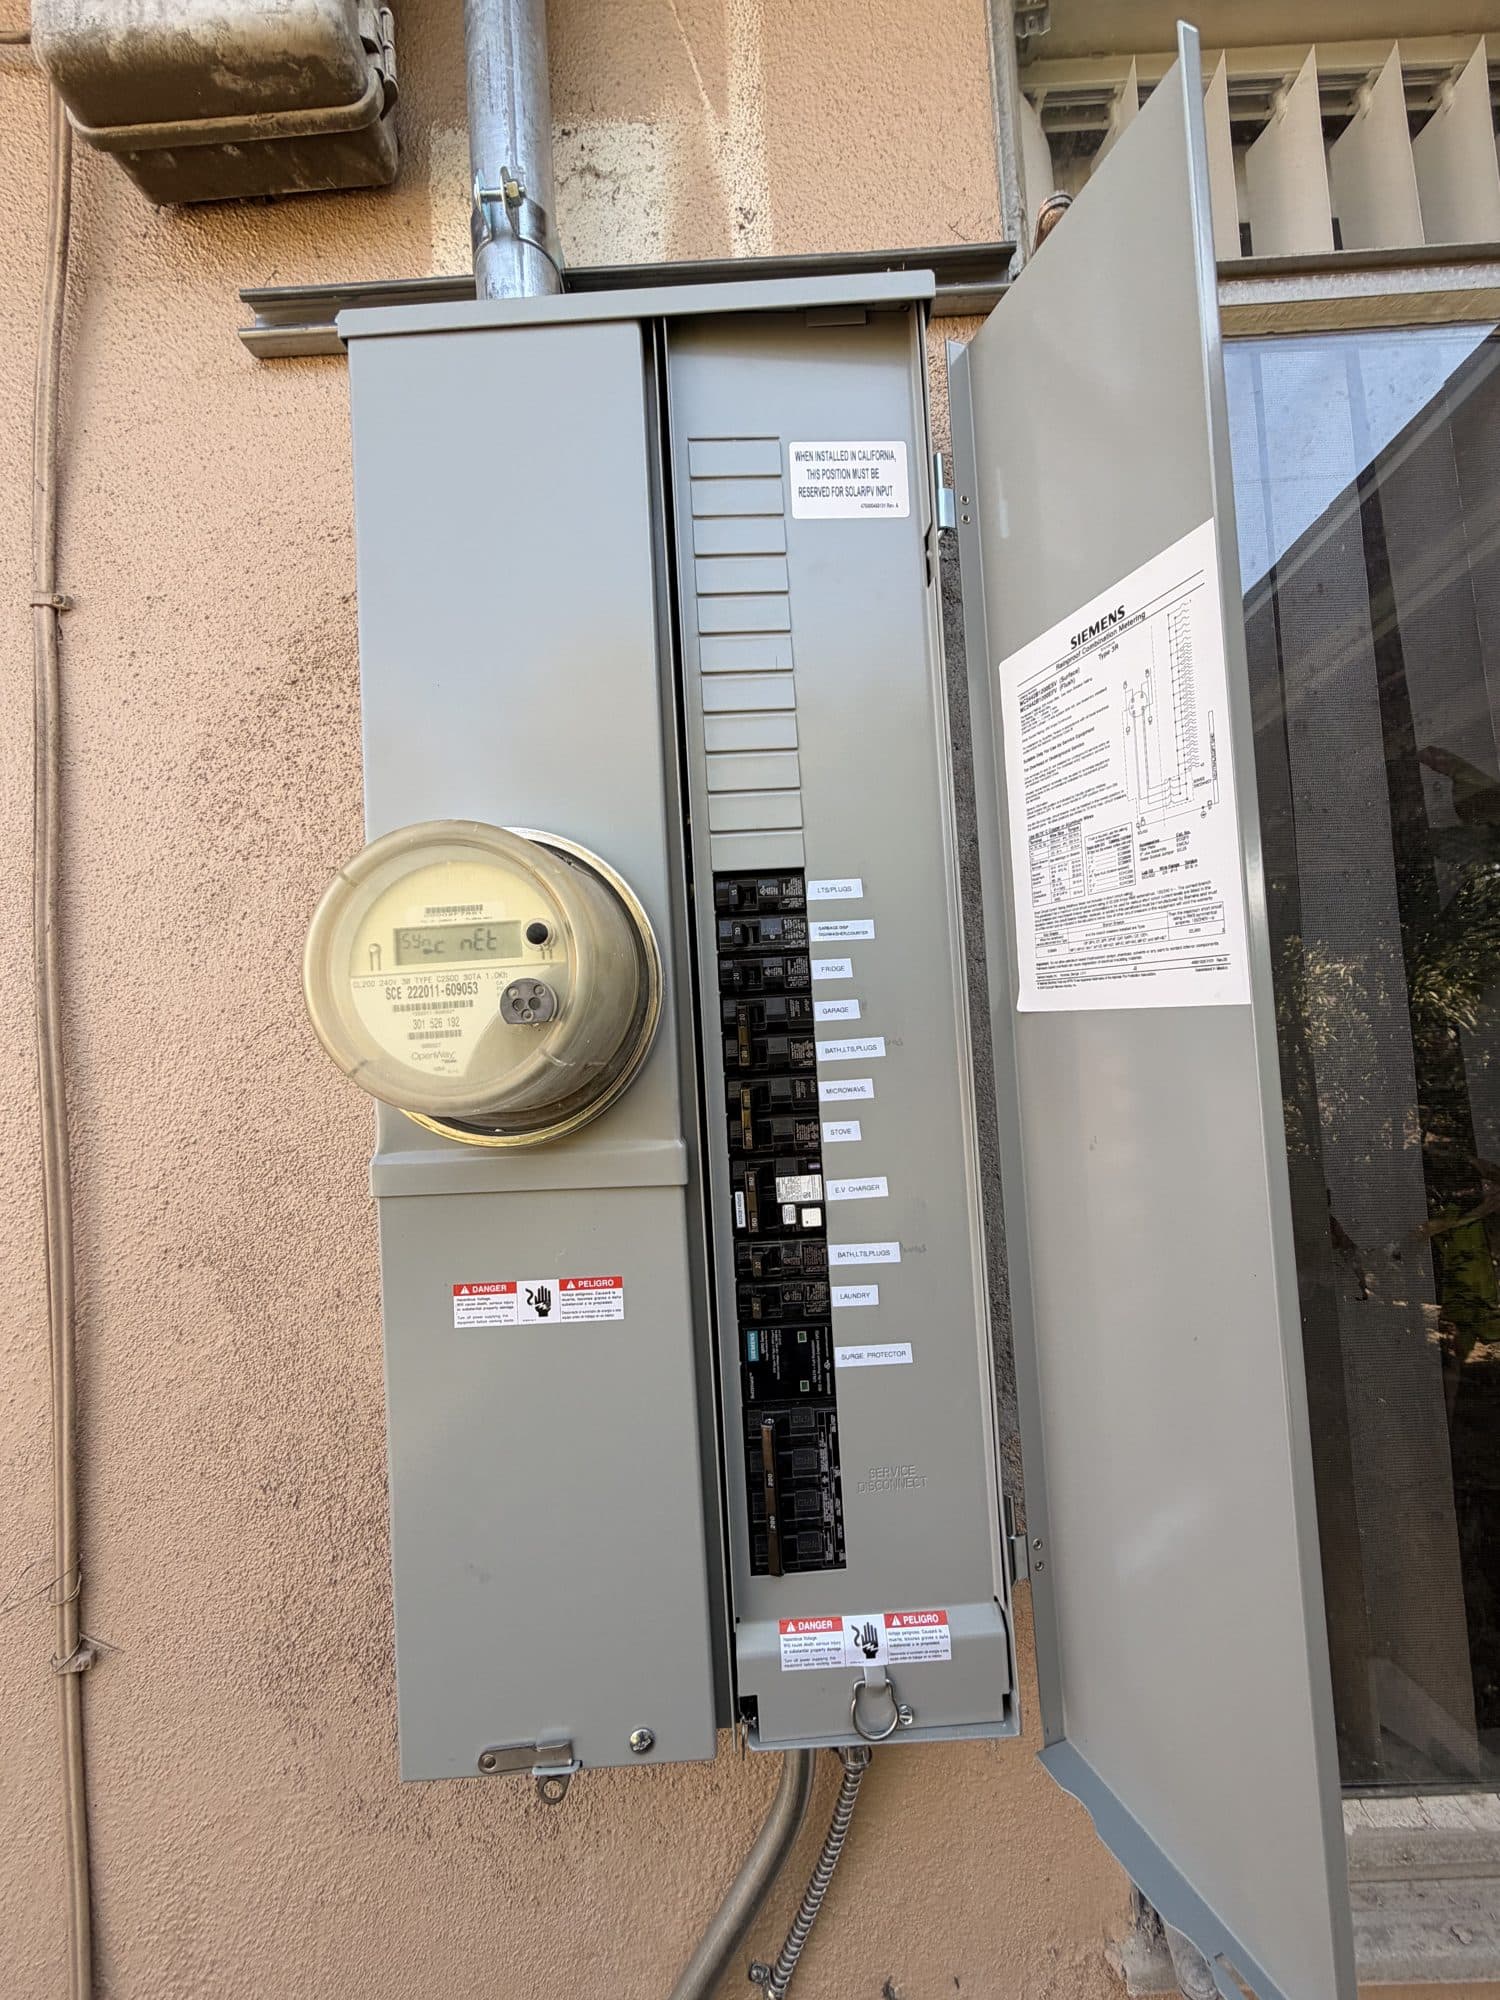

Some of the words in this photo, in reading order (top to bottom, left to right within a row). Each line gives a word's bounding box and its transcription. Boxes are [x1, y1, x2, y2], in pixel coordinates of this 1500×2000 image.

[795, 450, 814, 462] WHEN
[815, 450, 849, 461] INSTALLED
[850, 449, 857, 461] IN
[858, 449, 897, 462] CALIFORNIA,
[807, 468, 821, 480] THIS
[822, 468, 851, 479] POSITION
[852, 468, 870, 479] MUST
[871, 467, 880, 479] BE
[799, 486, 830, 498] RESERVED
[831, 486, 844, 497] FOR
[876, 485, 893, 496] INPUT
[1070, 605, 1126, 650] SIEMENS
[1082, 629, 1118, 654] Combination
[1118, 611, 1146, 632] Metering
[385, 987, 401, 1000] SCE
[407, 982, 478, 999] 222011-609053
[823, 1006, 848, 1014] GARAGE
[826, 1086, 867, 1095] MICROWAVE
[848, 1184, 880, 1192] CHARGER
[472, 1285, 507, 1293] DANGER
[578, 1280, 614, 1288] PELIGRO
[840, 1292, 871, 1300] LAUNDRY
[841, 1352, 863, 1360] SURGE
[867, 1350, 906, 1359] PROTECTOR
[869, 1464, 916, 1480] SERVICE
[857, 1476, 927, 1494] DISCONNECT
[903, 1615, 939, 1624] PELIGRO
[798, 1620, 833, 1630] DANGER
